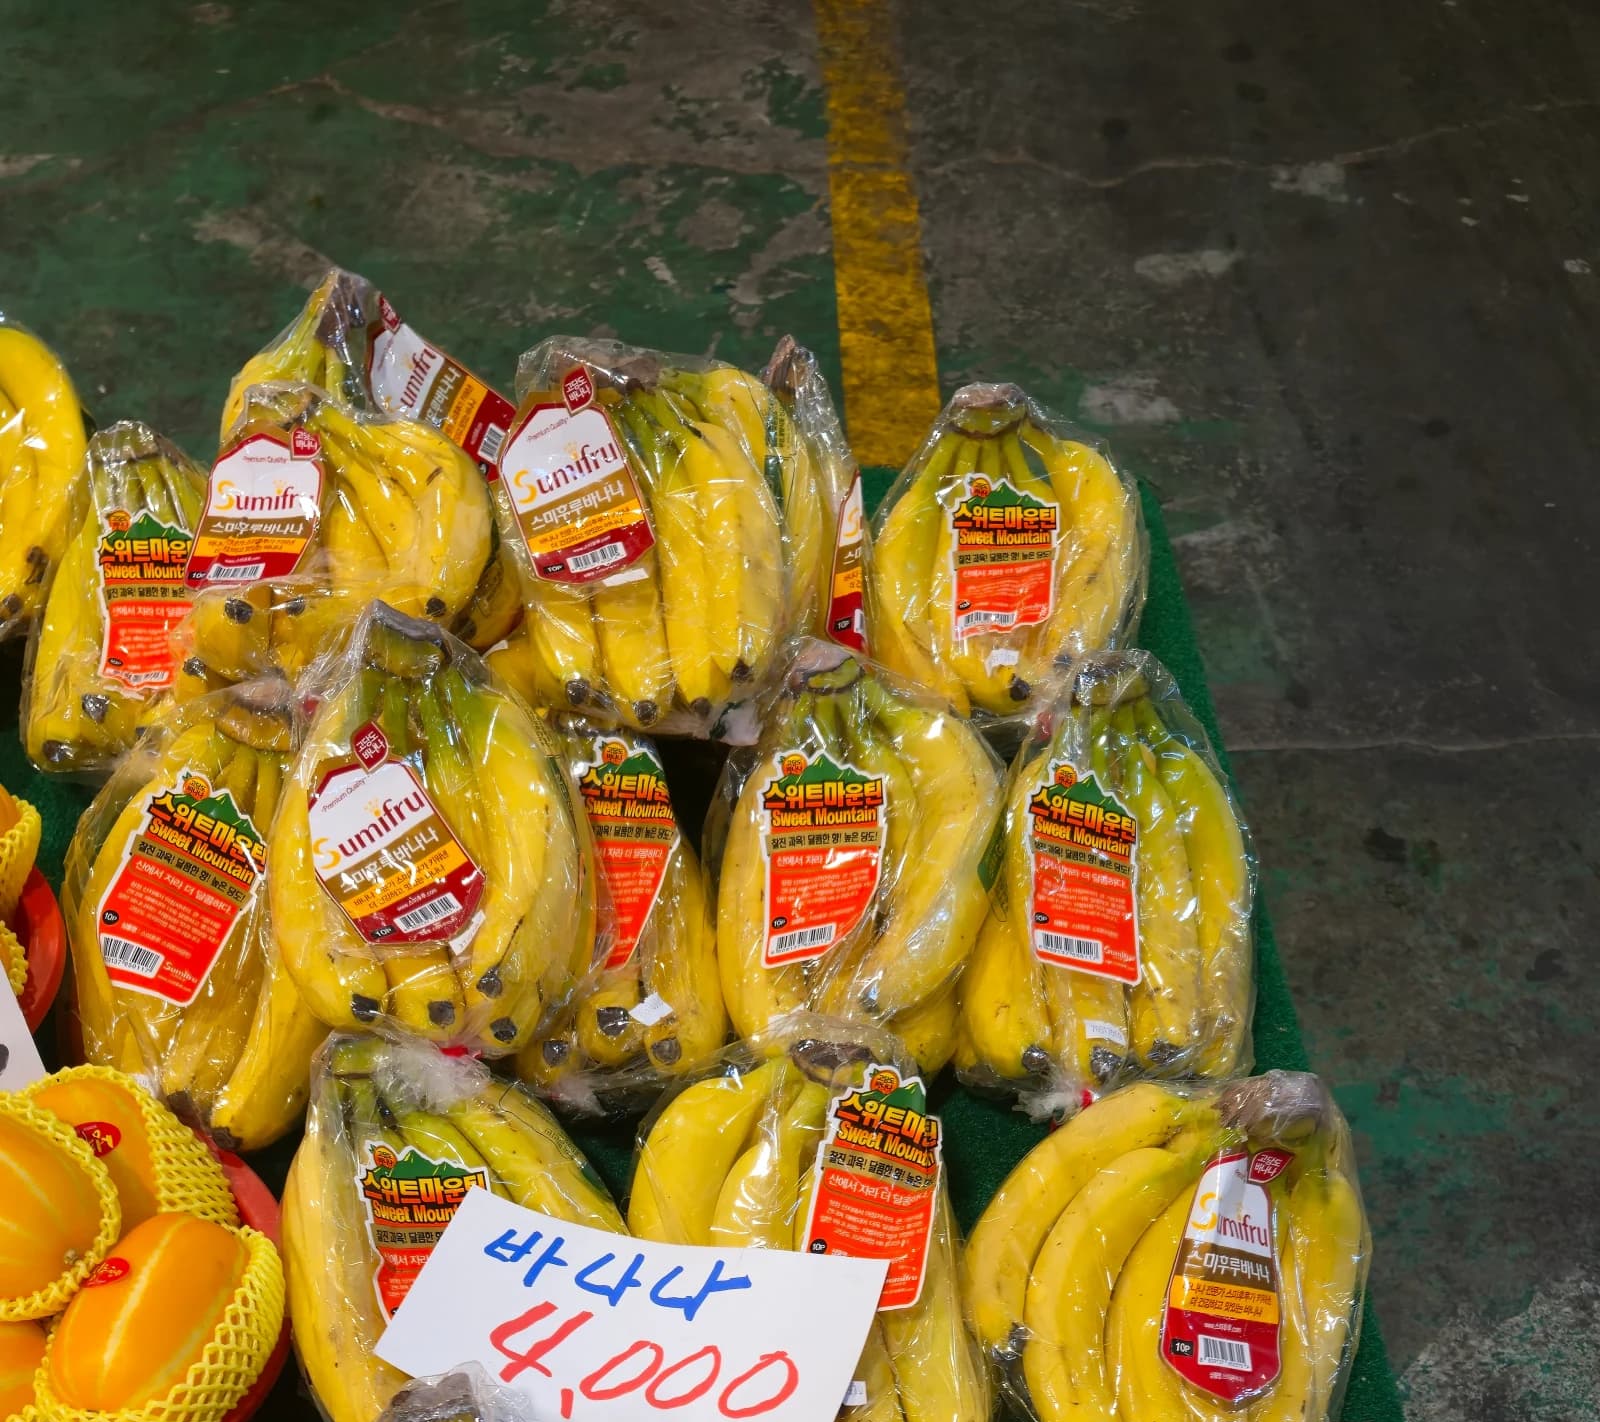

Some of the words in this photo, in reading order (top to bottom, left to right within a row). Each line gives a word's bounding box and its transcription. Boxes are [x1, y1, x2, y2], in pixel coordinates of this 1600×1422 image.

[514, 443, 618, 504] Sumifru
[532, 480, 625, 529] 스미후루바나나
[954, 503, 1056, 529] 스위트마운틴
[959, 529, 994, 544] Sweet
[997, 530, 1050, 544] Mountain
[105, 564, 141, 579] Sweet
[585, 798, 622, 817] Sweet
[765, 781, 883, 808] 스위트마운틴
[312, 792, 425, 869] Sumifru
[773, 808, 812, 826] Sweet
[816, 808, 876, 825] Mountain
[1030, 790, 1136, 842] 스위트마운틴
[150, 791, 266, 873] 스위트마운틴
[1035, 816, 1071, 841] Sweet
[1073, 829, 1129, 856] Mountain
[151, 817, 191, 851] Sweet
[191, 840, 254, 884] Mountain
[839, 1121, 882, 1146] Sweet
[1254, 1164, 1277, 1176] 바나나
[1258, 1154, 1282, 1167] 고당도
[373, 1201, 411, 1222] Sweet
[1192, 1192, 1269, 1247] Sumifru
[484, 1227, 752, 1321] 바나나
[1185, 1250, 1270, 1283] 스미후루바나나
[490, 1302, 800, 1418] 4,000
[1175, 1343, 1190, 1352] 10P
